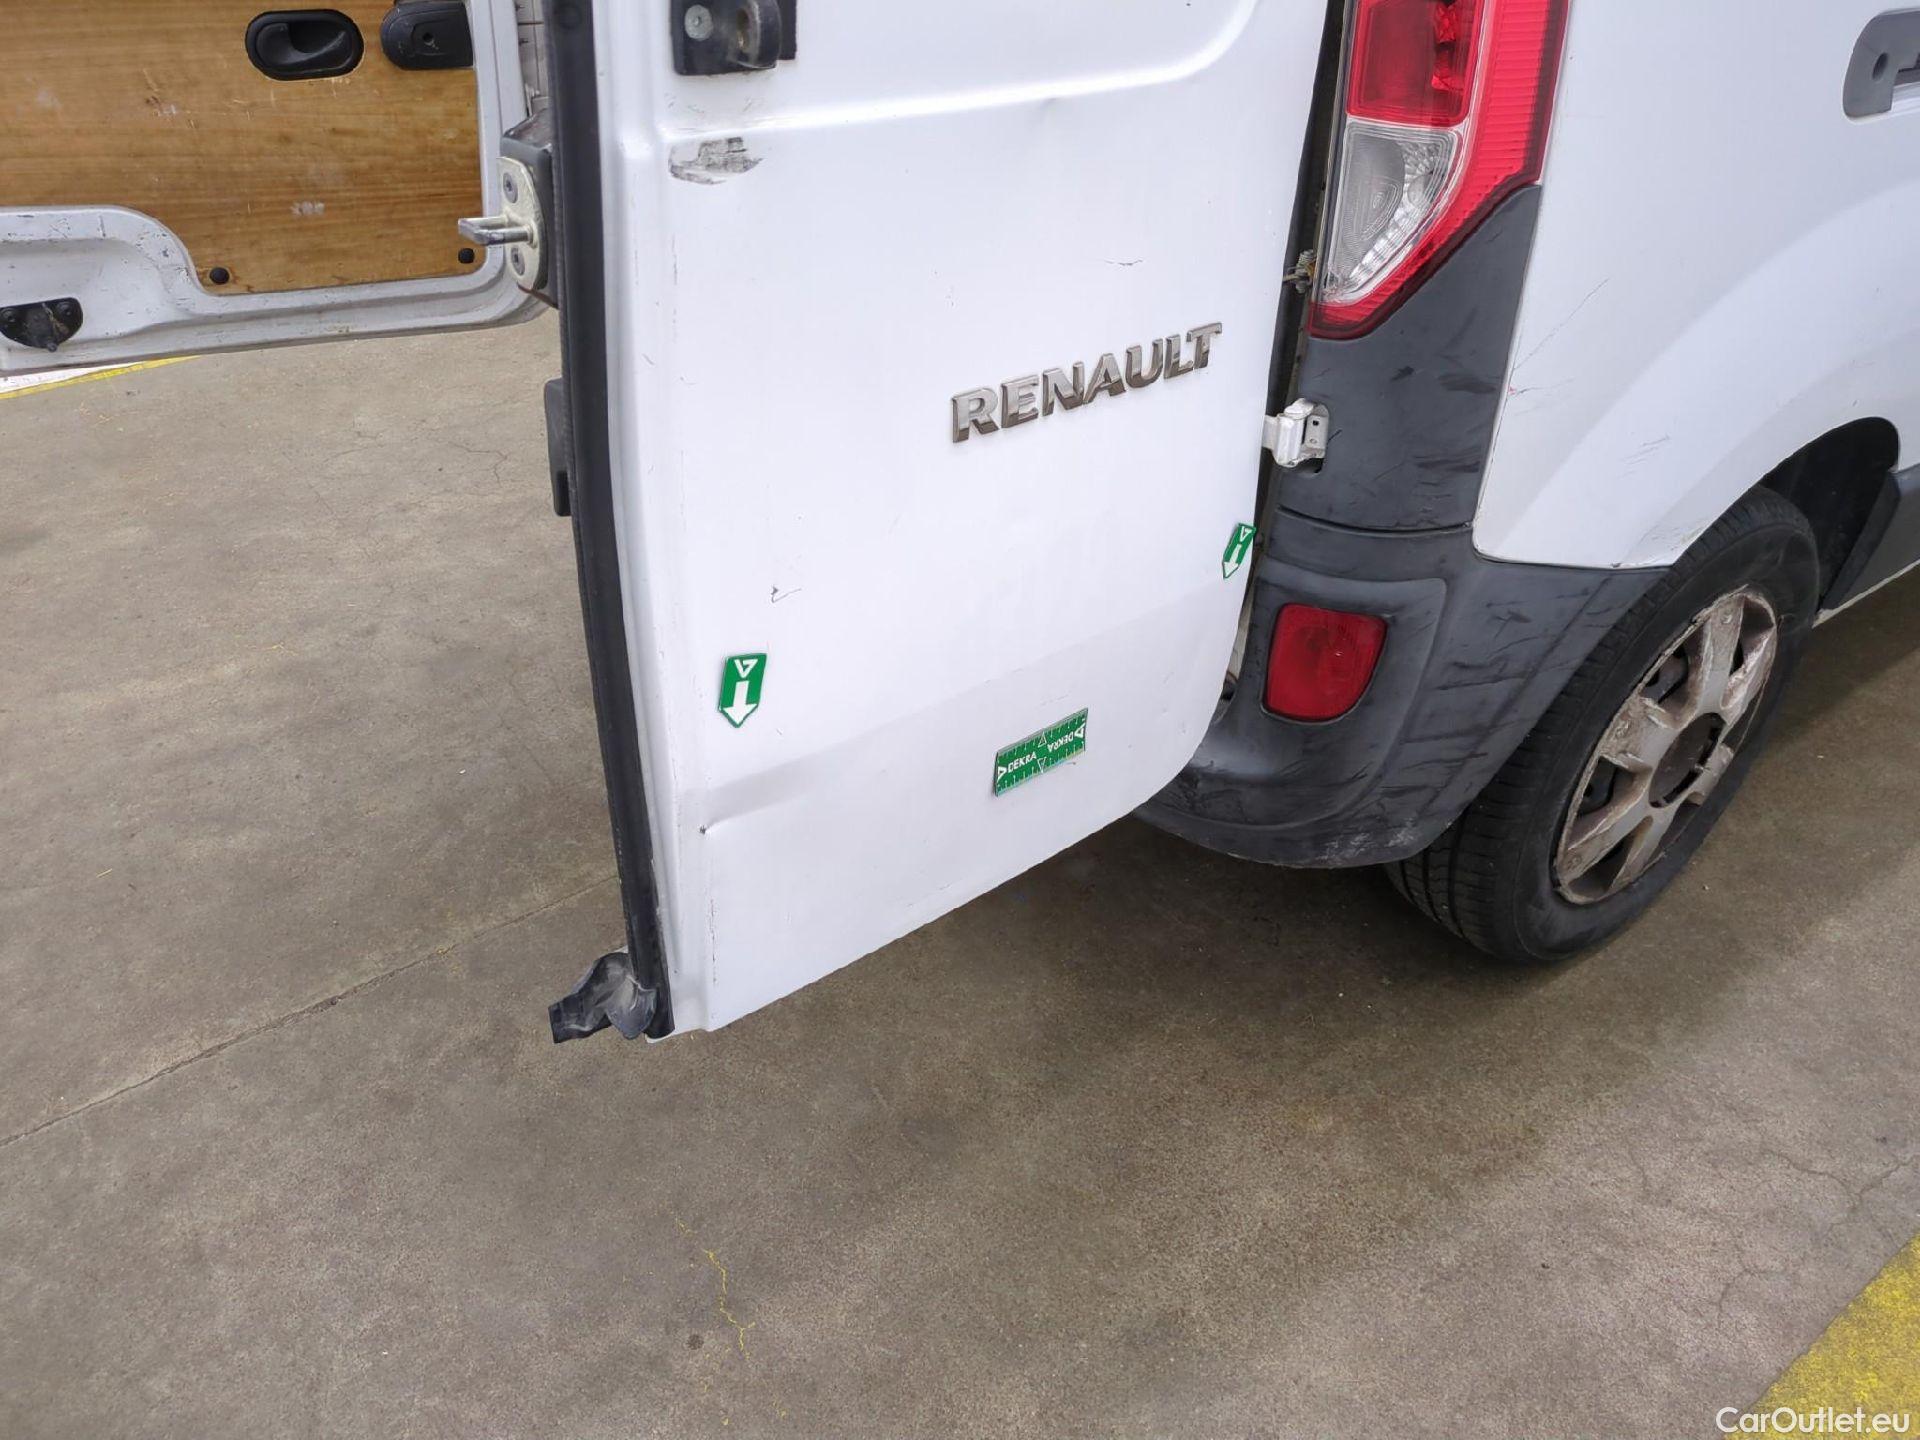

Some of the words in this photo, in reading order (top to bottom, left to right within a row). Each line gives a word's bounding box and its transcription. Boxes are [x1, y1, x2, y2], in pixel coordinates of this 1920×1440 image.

[951, 322, 1222, 443] RENAULT
[1047, 731, 1074, 752] DEKRA
[1008, 751, 1037, 772] DEKRA
